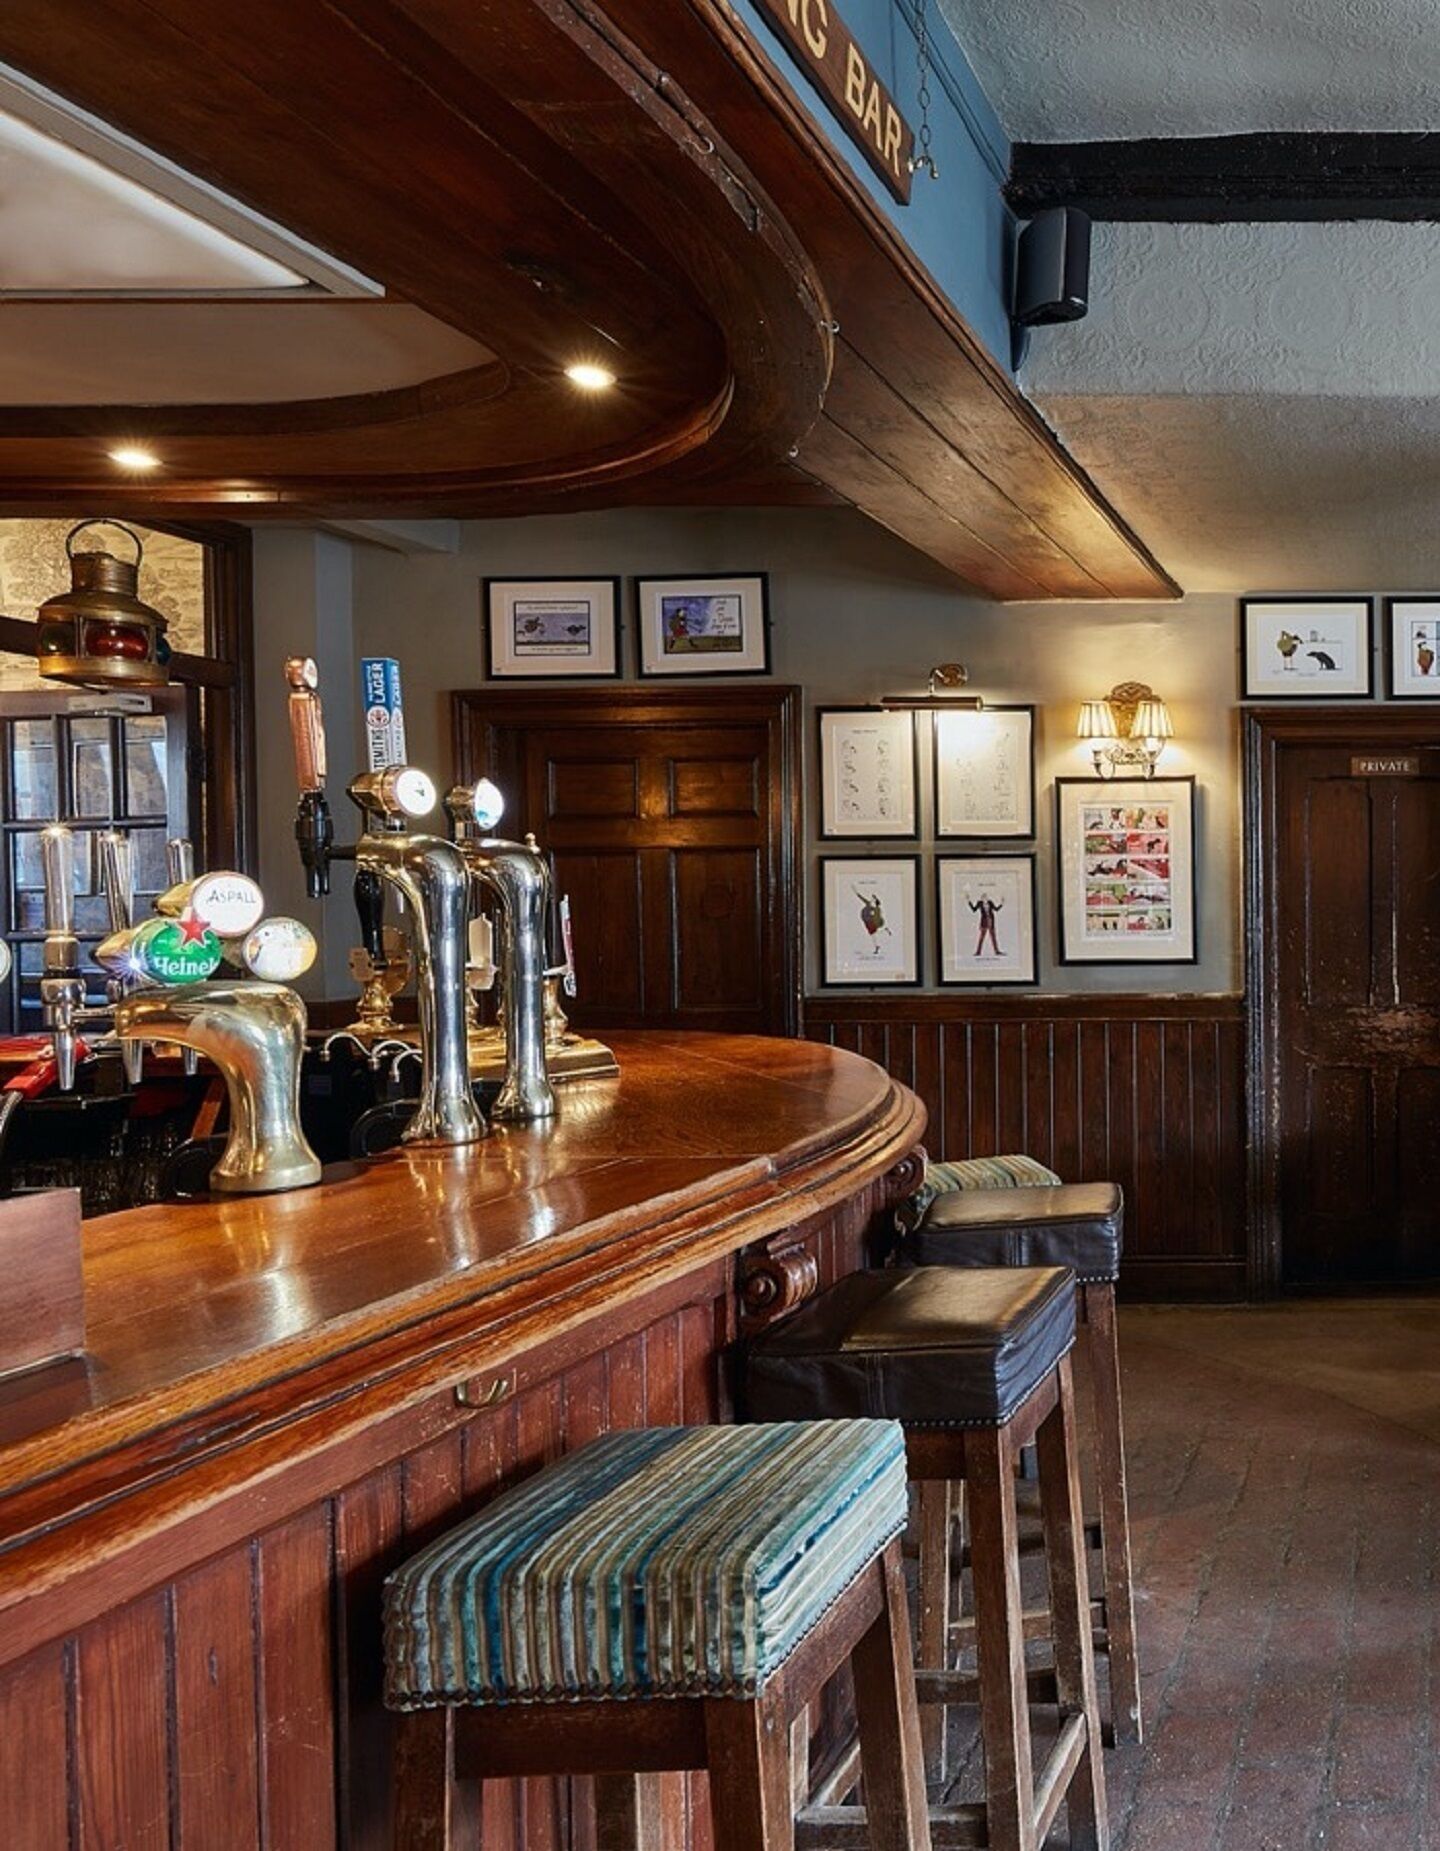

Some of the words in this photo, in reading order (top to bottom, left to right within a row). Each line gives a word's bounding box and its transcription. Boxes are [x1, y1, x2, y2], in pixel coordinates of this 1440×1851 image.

[845, 43, 902, 177] BAR
[372, 662, 386, 704] LAGER
[1360, 761, 1409, 772] PRIVATE
[206, 889, 257, 904] ASPALL
